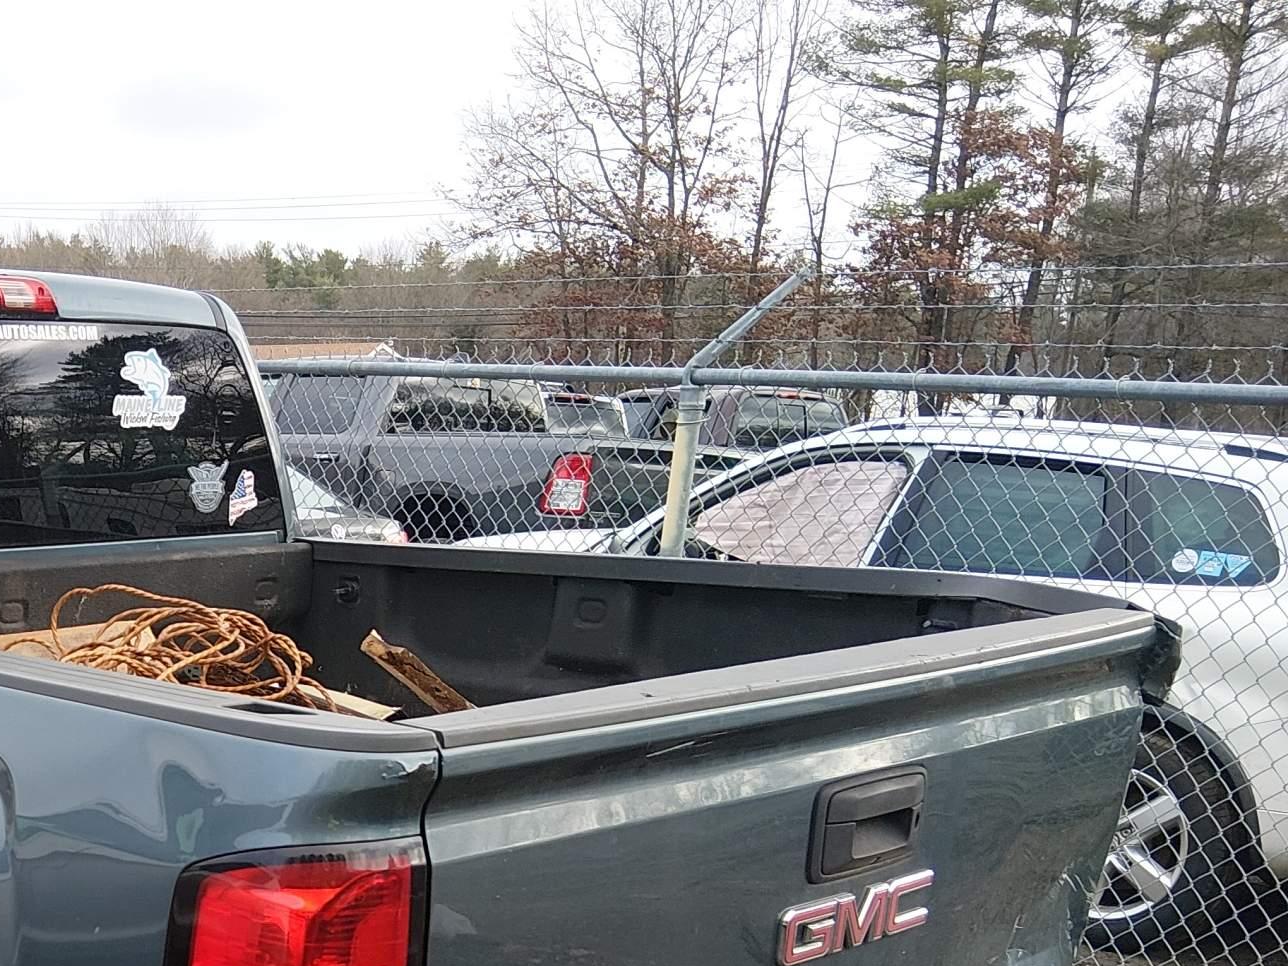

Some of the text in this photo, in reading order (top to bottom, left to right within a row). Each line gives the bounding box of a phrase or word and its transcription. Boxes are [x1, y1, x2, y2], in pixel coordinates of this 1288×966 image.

[114, 396, 185, 415] MAINE LINE
[777, 869, 934, 966] GMC
